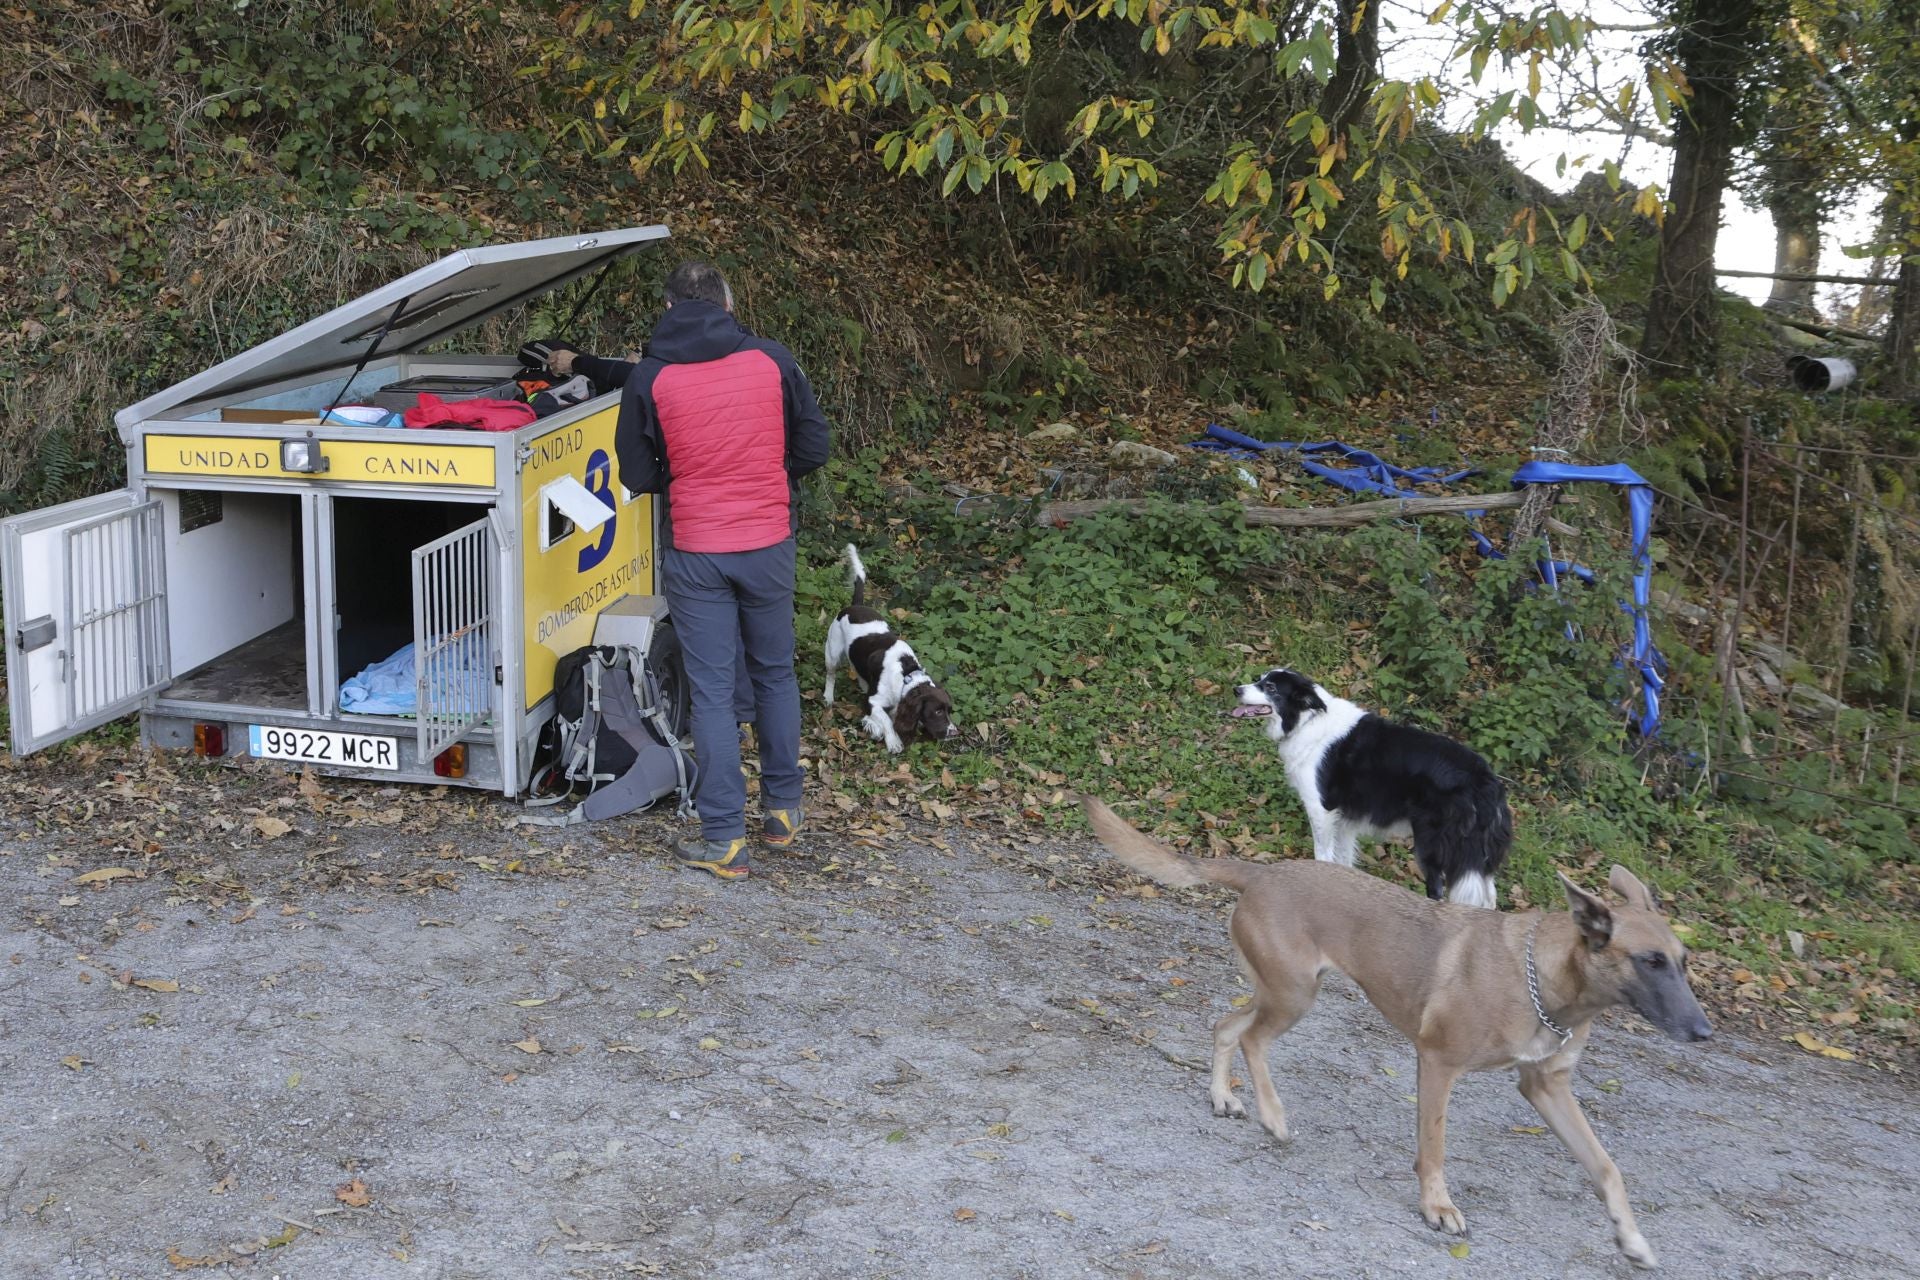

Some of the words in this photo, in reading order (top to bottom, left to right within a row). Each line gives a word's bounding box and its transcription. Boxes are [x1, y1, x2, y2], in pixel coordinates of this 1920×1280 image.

[179, 449, 269, 469] UNIDAD
[364, 456, 459, 477] CANINA
[531, 428, 583, 469] UNIDAD
[537, 587, 594, 644] BOMBEROS
[595, 577, 608, 603] DE
[610, 549, 650, 591] ASTURIAS
[266, 730, 332, 760] 9922
[341, 736, 391, 766] MCR
